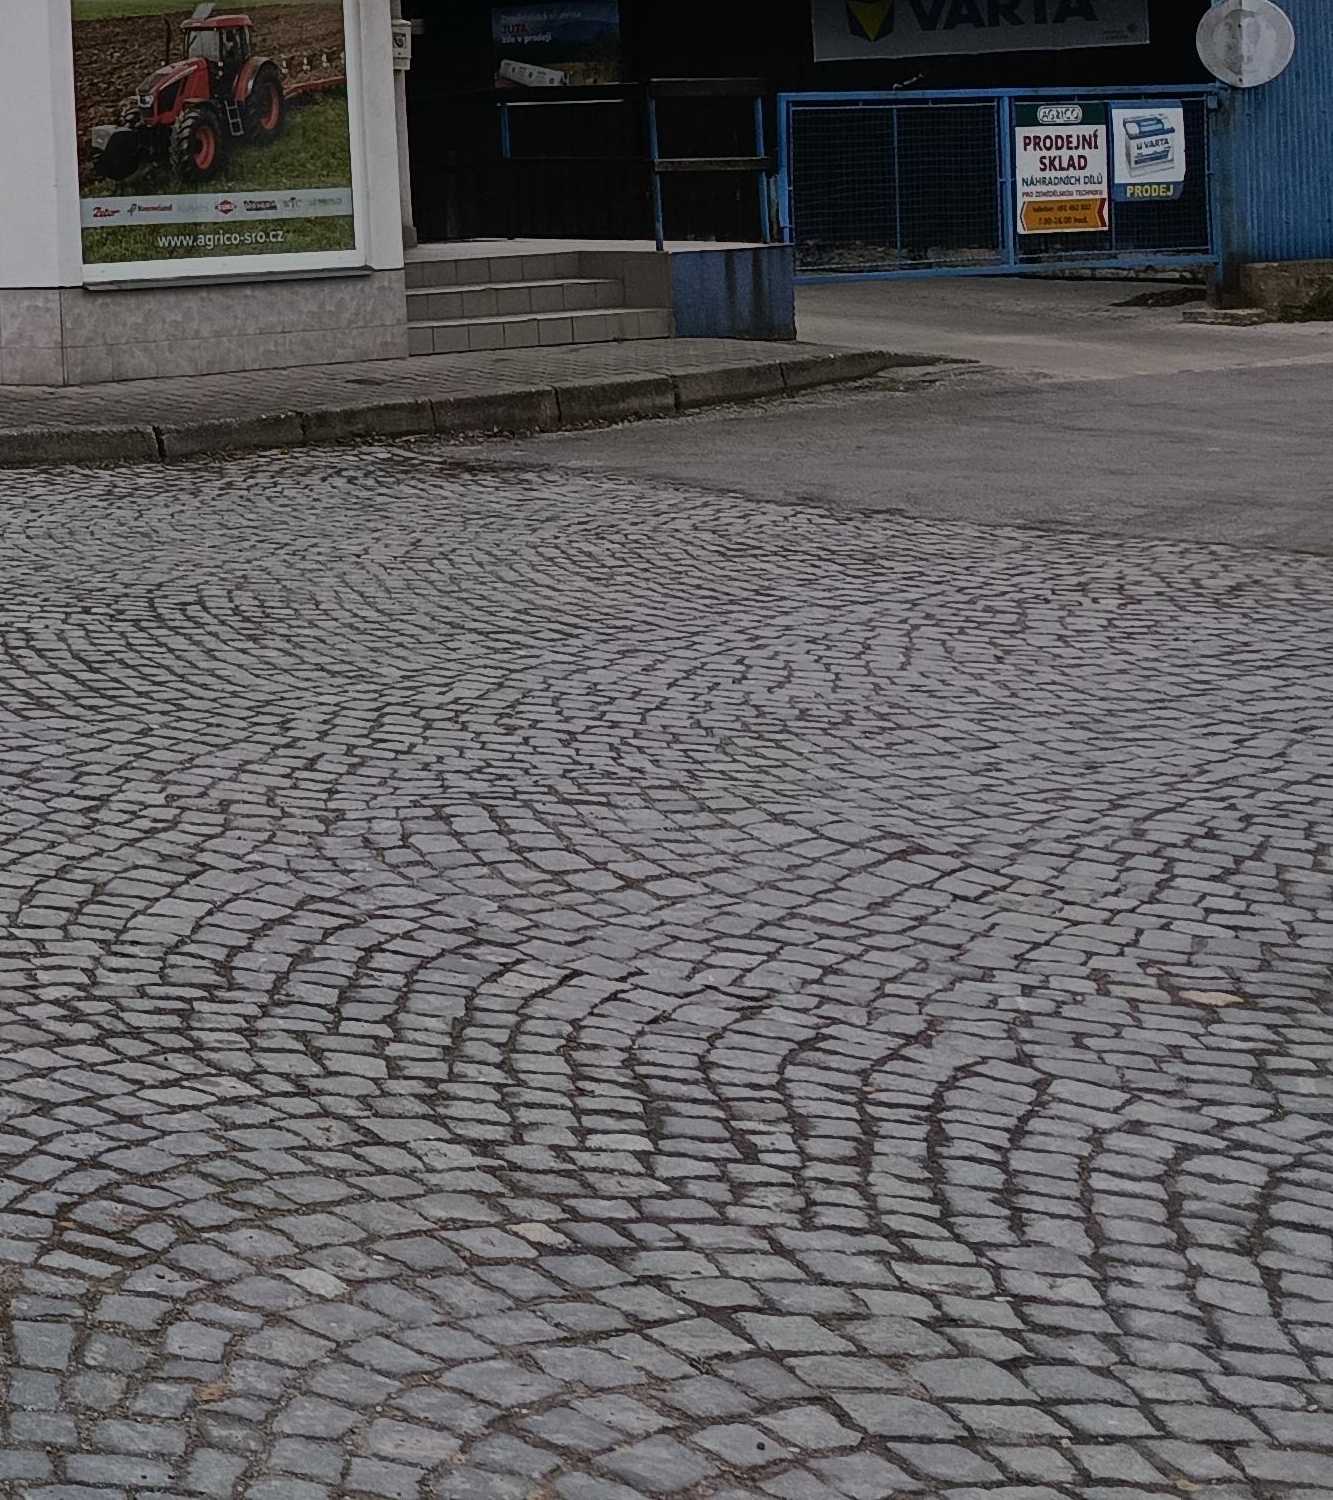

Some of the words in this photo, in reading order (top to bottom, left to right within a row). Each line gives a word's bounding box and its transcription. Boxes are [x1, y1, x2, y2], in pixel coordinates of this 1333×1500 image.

[1023, 129, 1099, 152] PRODEJNÍ
[1144, 138, 1169, 149] VARTA
[1039, 155, 1087, 172] SKLAD
[1022, 175, 1081, 187] NÁHRADNÍCH
[1083, 172, 1103, 185] DÍLŮ
[1126, 184, 1174, 197] PRODEJ
[157, 229, 285, 250] www.agrico-sro.cz
